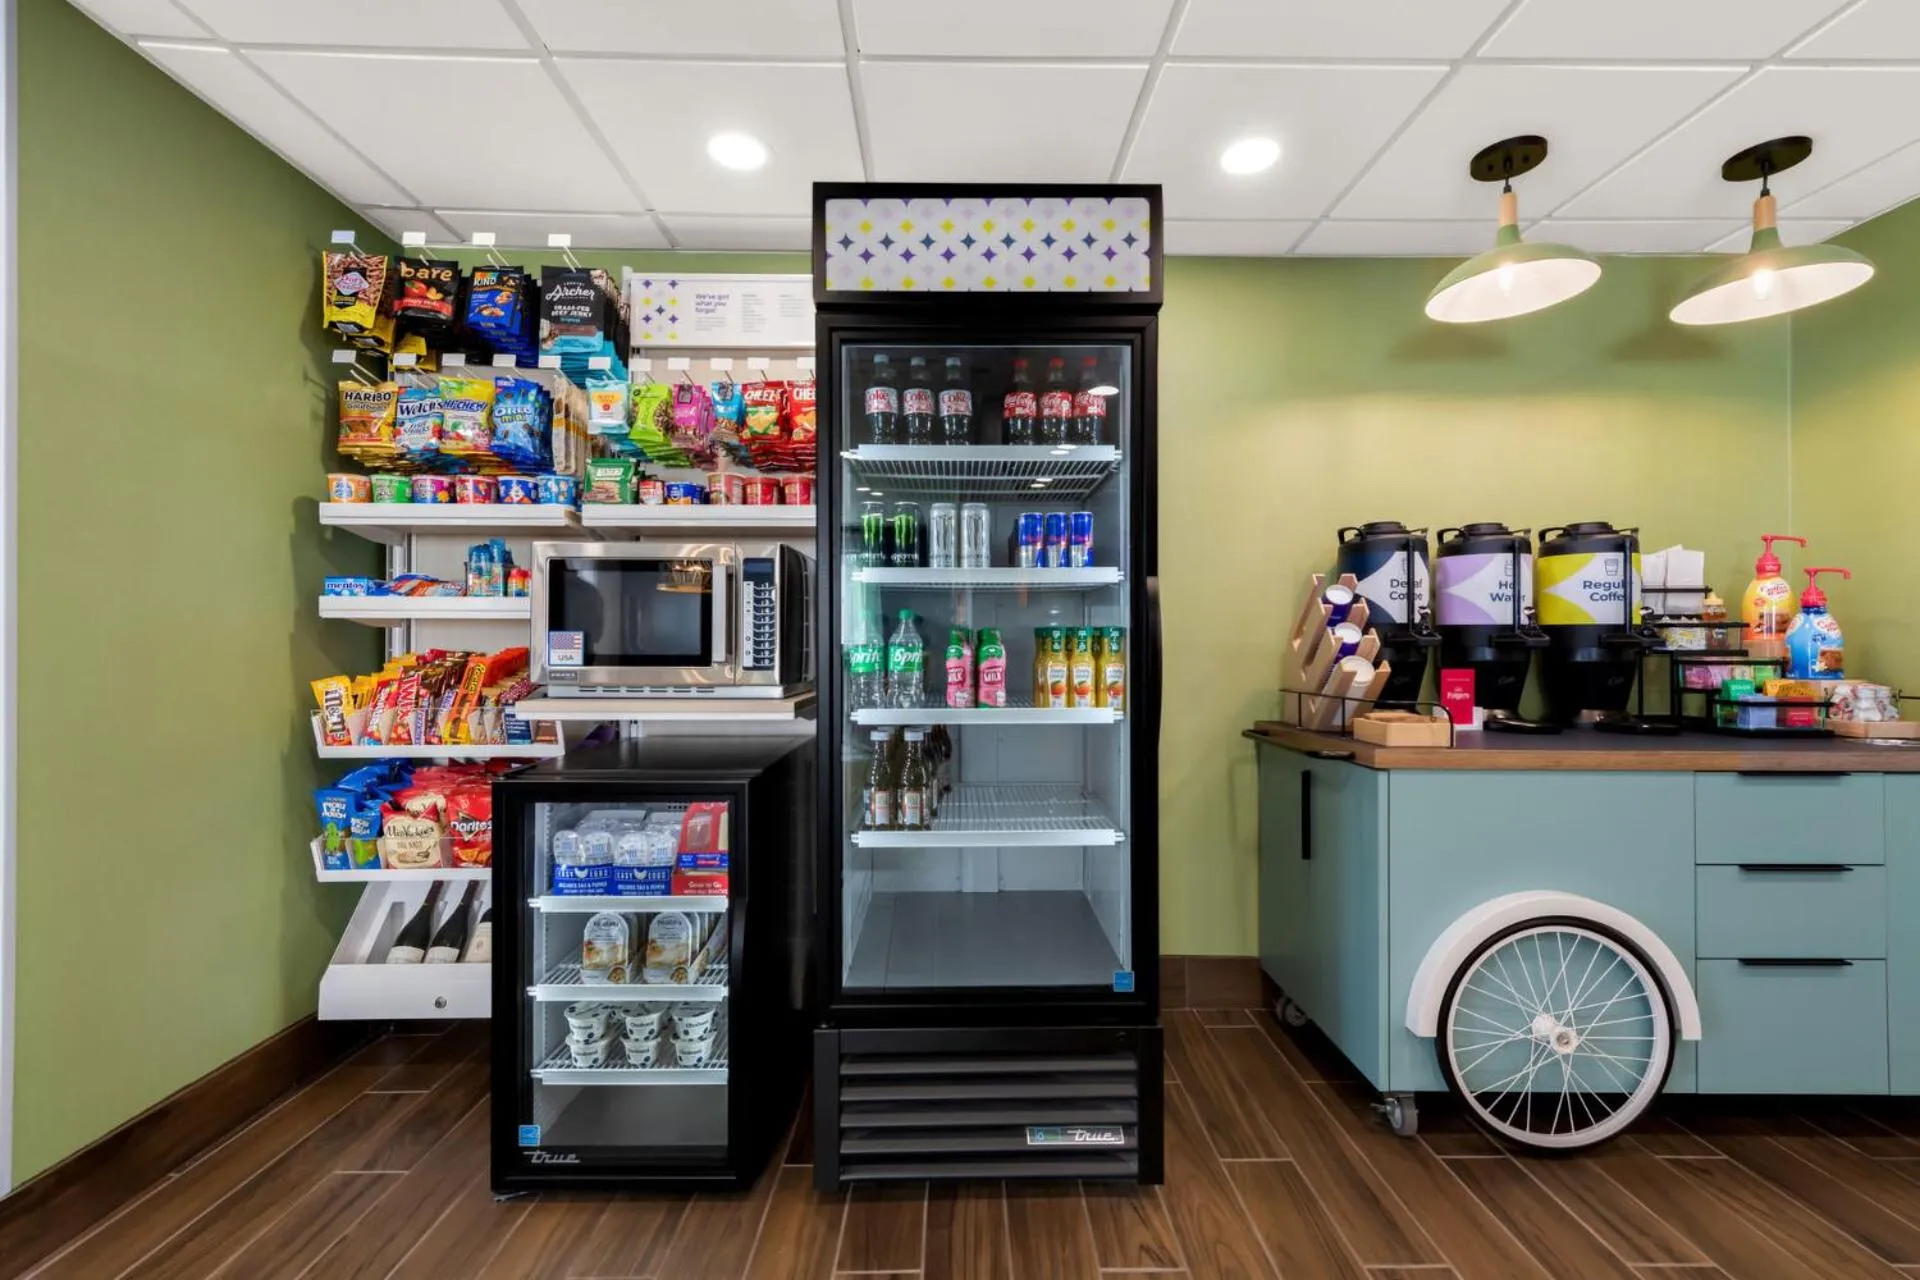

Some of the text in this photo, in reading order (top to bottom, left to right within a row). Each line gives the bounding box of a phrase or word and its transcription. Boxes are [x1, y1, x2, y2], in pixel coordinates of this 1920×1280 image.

[400, 261, 453, 281] bare
[474, 278, 497, 287] KIND
[545, 284, 595, 302] Archer
[345, 391, 392, 402] HARIBO
[399, 402, 443, 416] Welch's
[494, 407, 533, 418] OREO
[327, 582, 364, 590] mentos
[1499, 580, 1514, 589] Ho
[1583, 579, 1626, 592] Regul
[1590, 591, 1625, 602] Coffe
